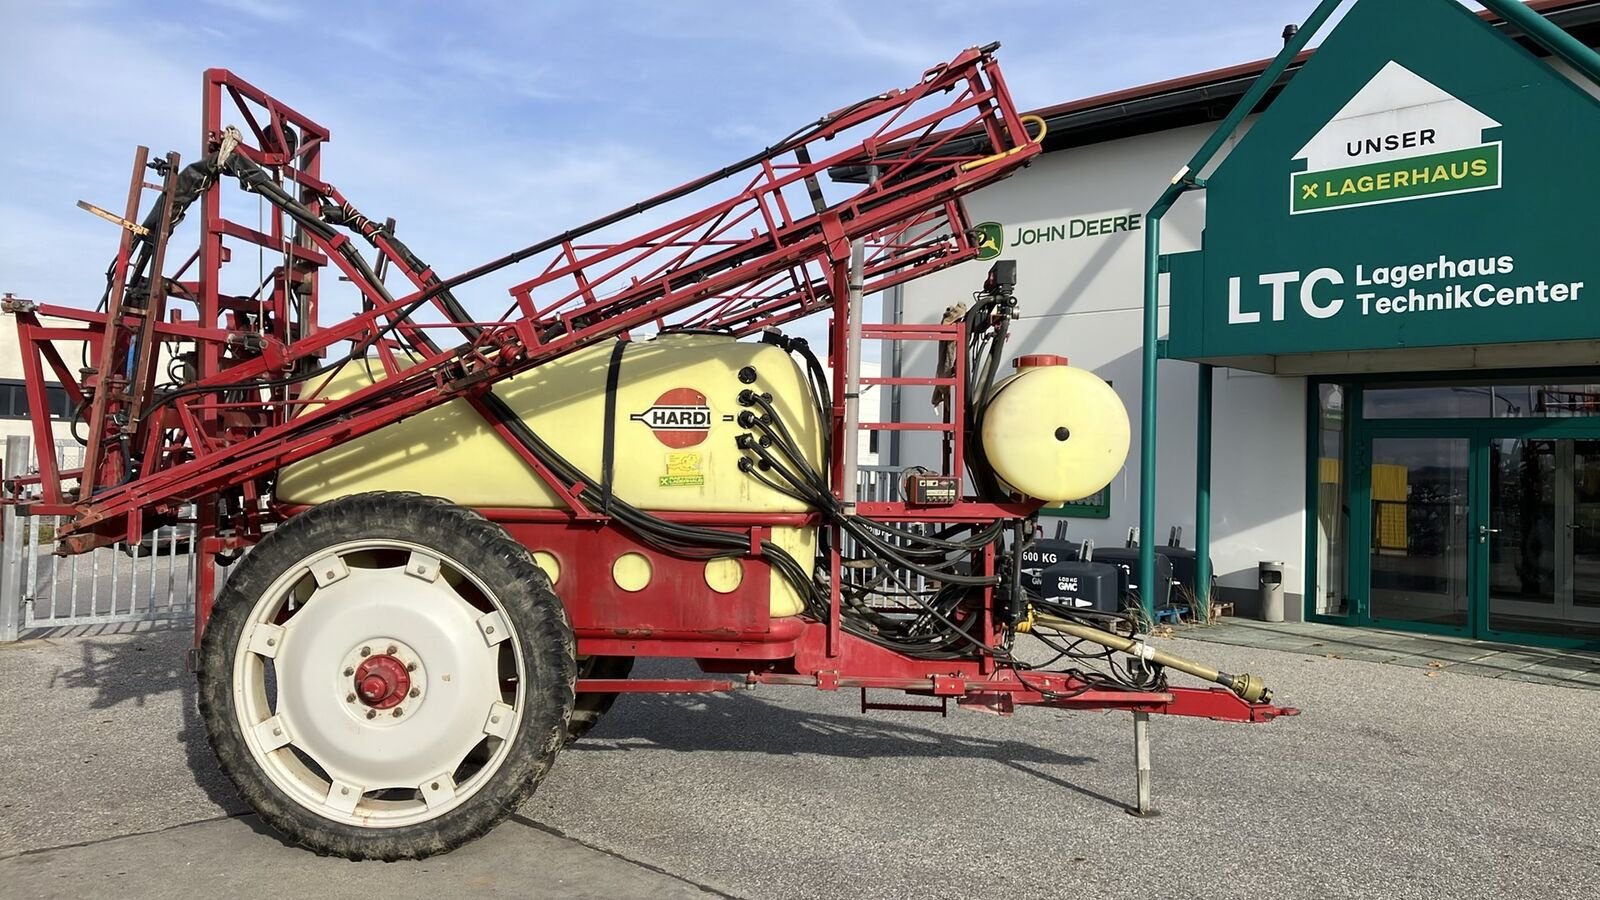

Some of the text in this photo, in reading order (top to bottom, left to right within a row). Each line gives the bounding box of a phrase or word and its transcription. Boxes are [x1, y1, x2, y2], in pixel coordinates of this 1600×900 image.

[1346, 128, 1436, 157] UNSER
[1325, 159, 1488, 197] LAGERHAUS
[1010, 213, 1142, 247] JOHN DEERE
[1355, 255, 1514, 289] Lagerhaus
[1228, 267, 1345, 325] LTC
[1355, 280, 1584, 315] TechnikCenter
[652, 411, 711, 425] HARDI
[1022, 551, 1057, 563] 600 KG
[1057, 581, 1078, 592] GMC
